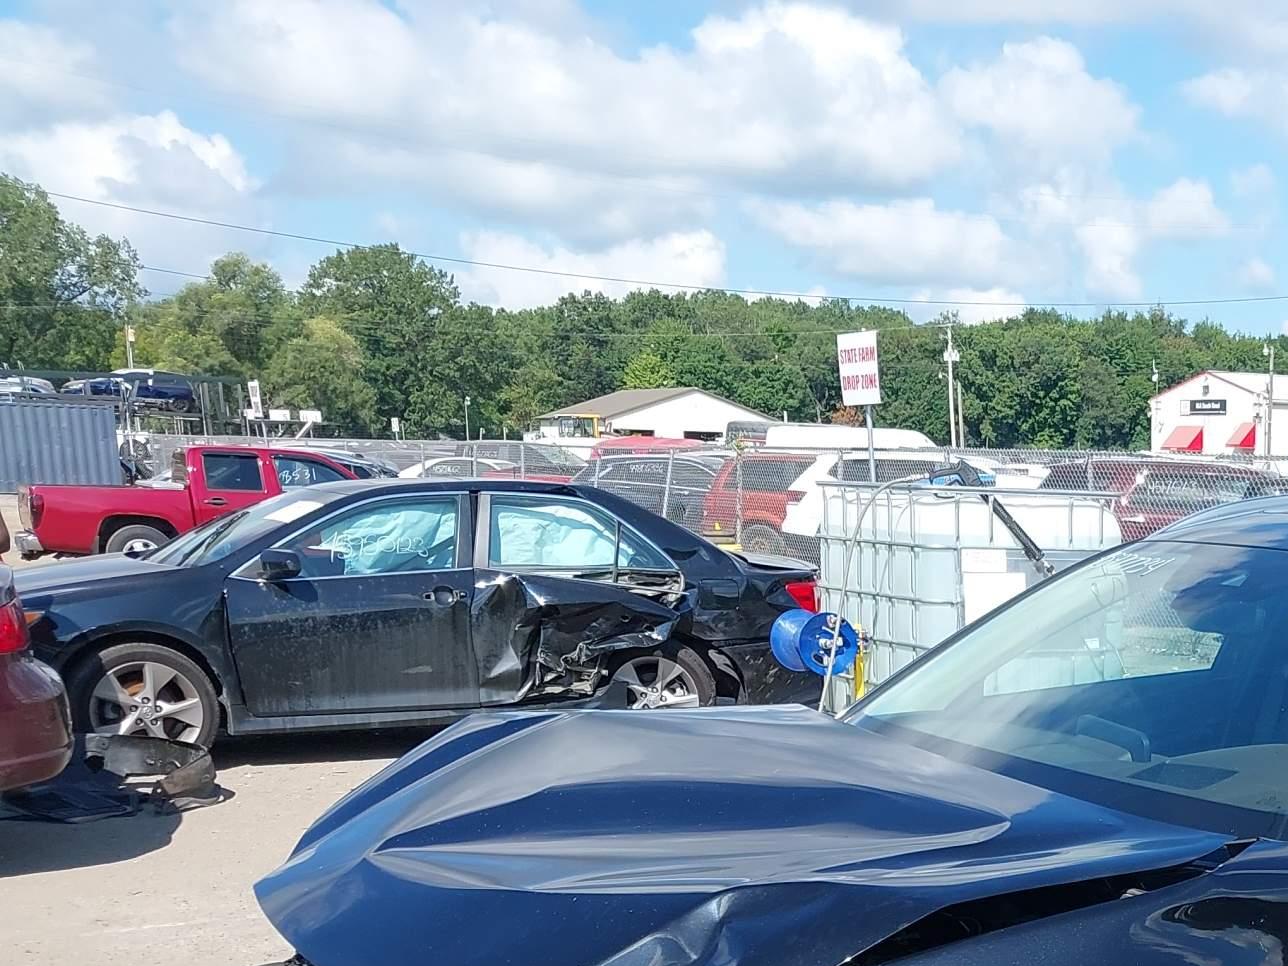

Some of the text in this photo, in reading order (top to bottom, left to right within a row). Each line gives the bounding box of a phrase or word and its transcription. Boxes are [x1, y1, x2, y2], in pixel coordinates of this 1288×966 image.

[840, 346, 875, 364] STATE FARM
[842, 373, 877, 390] DROP ZONE
